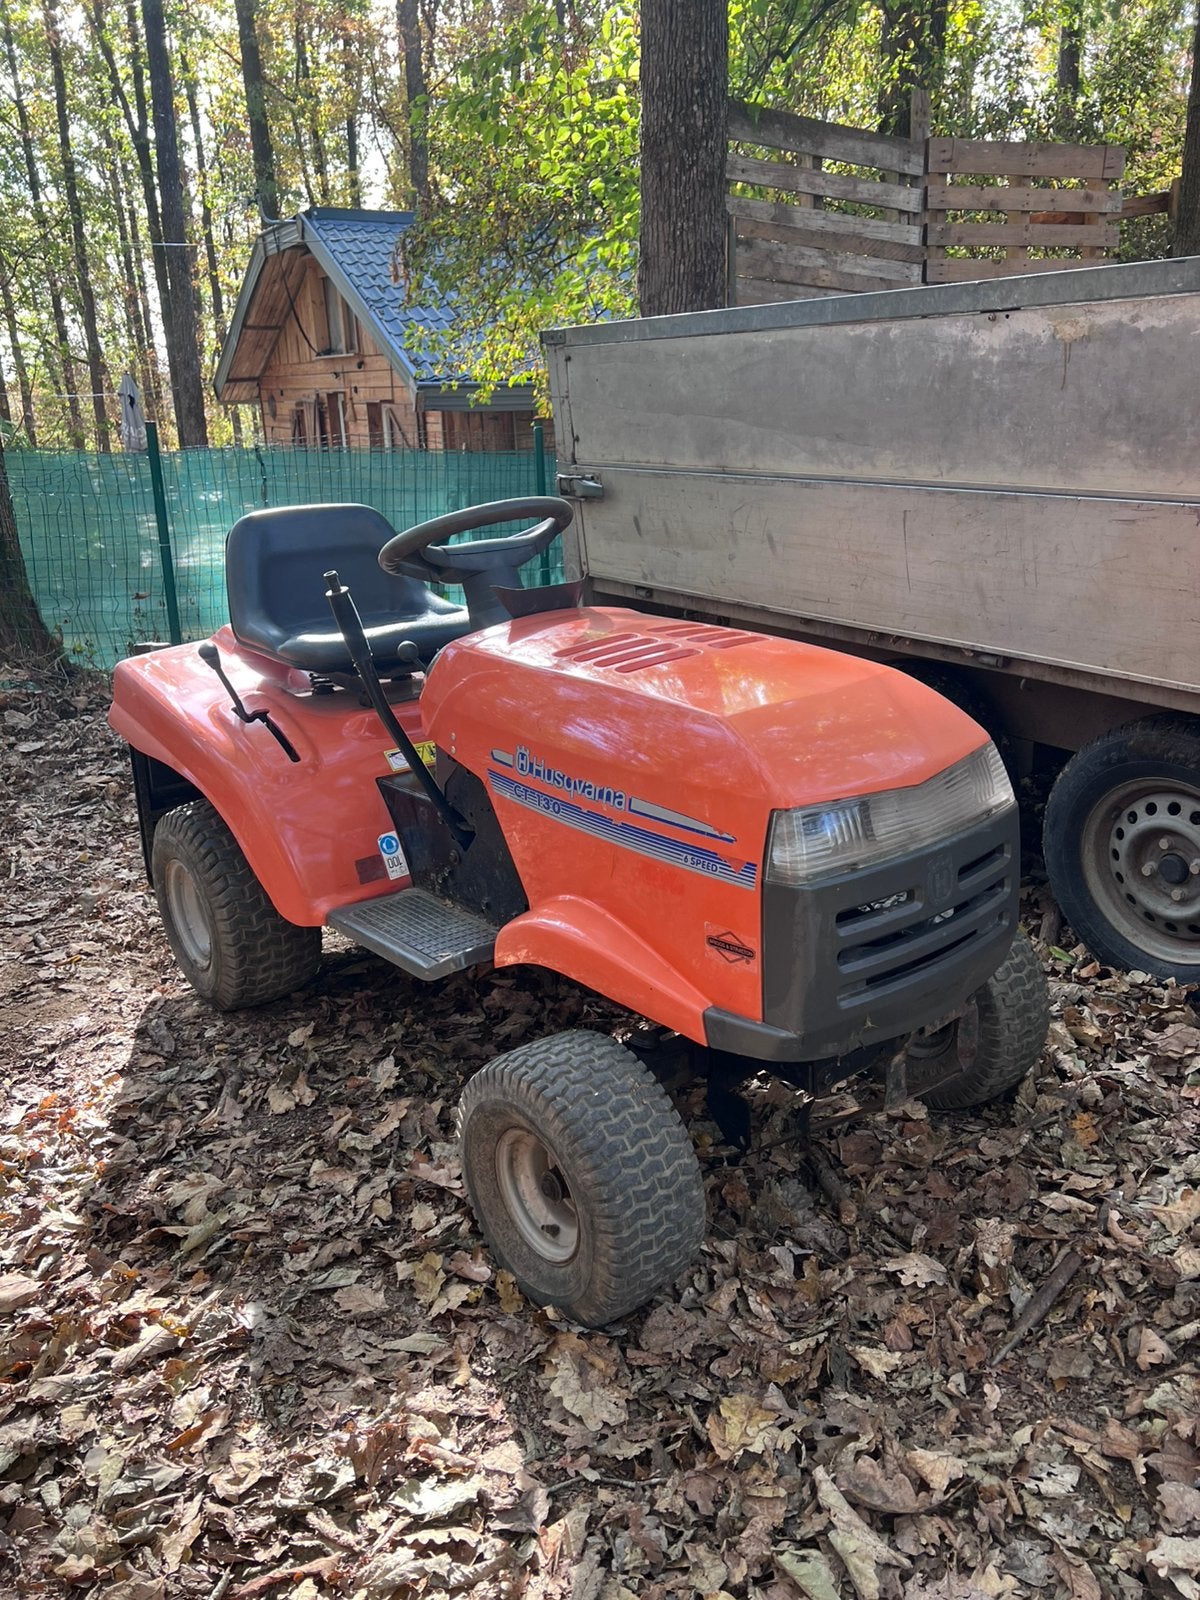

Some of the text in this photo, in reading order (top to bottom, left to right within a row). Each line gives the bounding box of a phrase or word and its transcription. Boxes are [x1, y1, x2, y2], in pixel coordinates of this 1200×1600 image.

[532, 756, 626, 811] Husqvarna
[536, 793, 561, 815] 130
[683, 855, 718, 873] 6 SPEED
